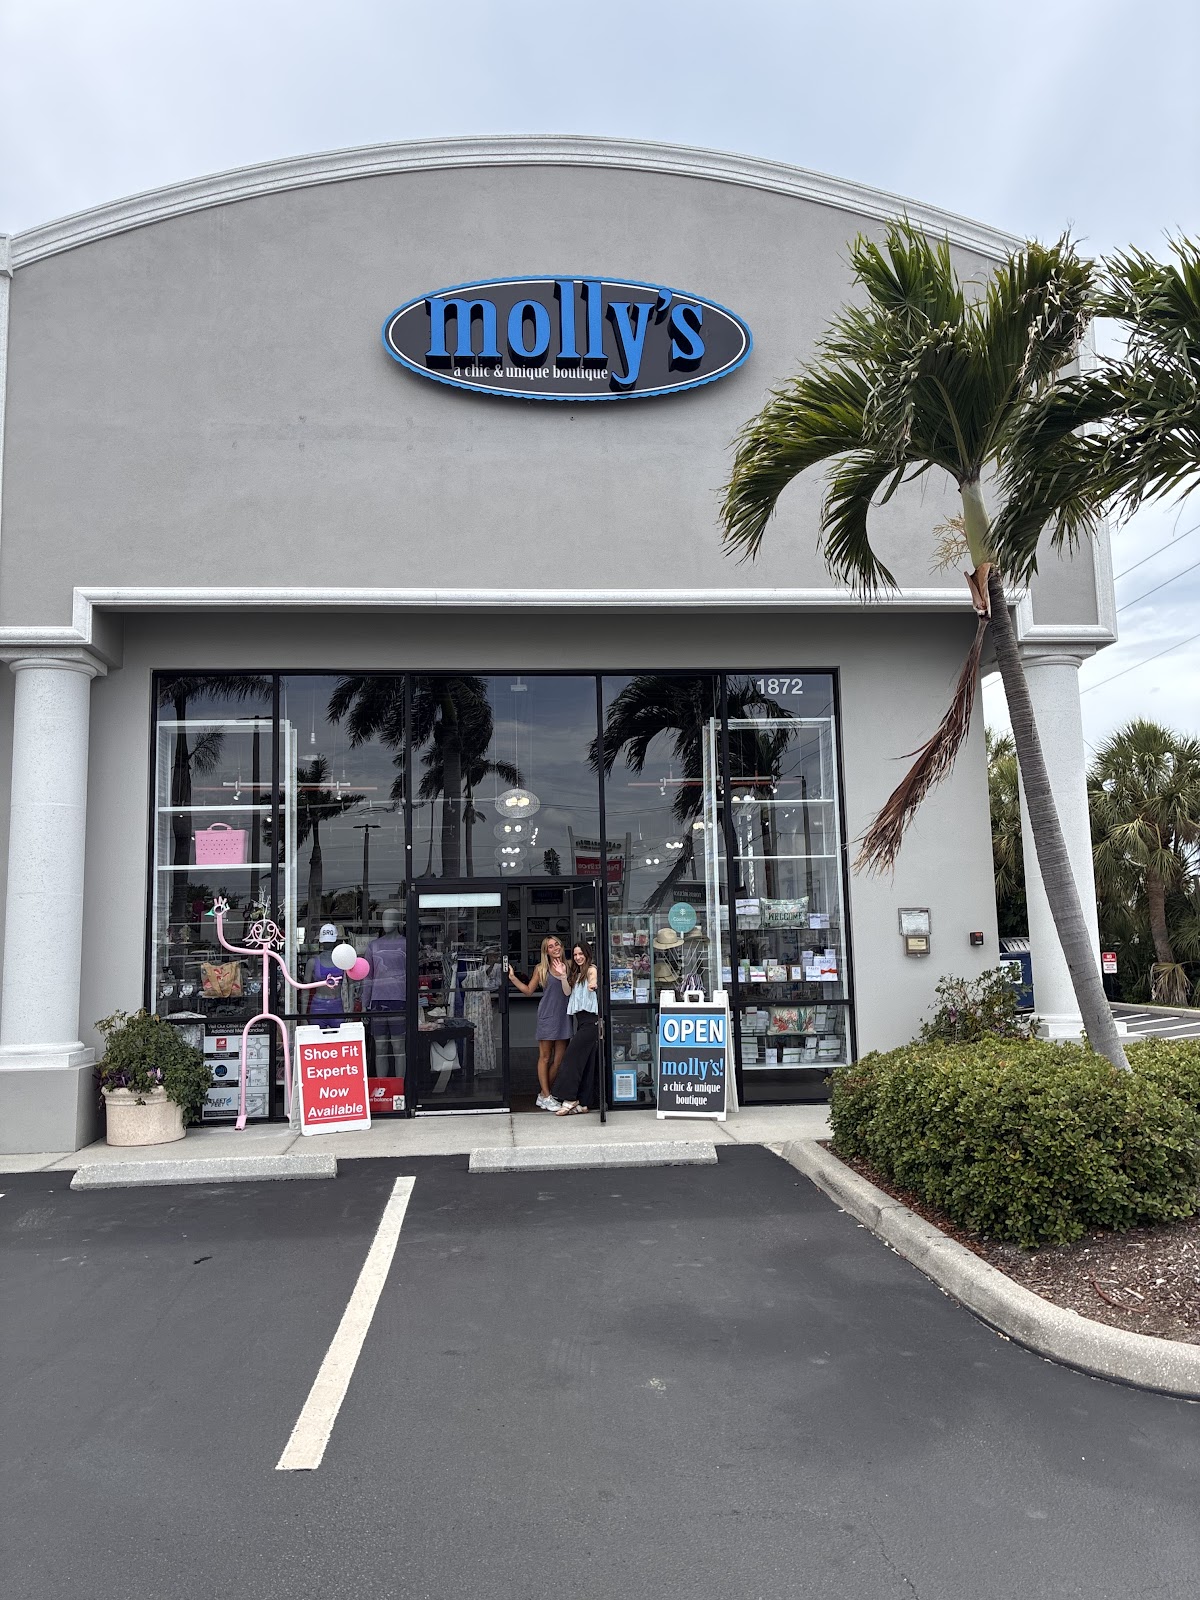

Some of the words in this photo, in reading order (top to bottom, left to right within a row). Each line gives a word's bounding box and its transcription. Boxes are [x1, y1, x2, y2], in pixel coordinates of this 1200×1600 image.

[425, 280, 705, 385] molly's
[453, 366, 462, 377] a
[464, 364, 490, 377] chic
[493, 364, 503, 377] &
[506, 366, 549, 380] unique
[552, 365, 608, 381] boutique
[757, 678, 803, 695] 1872
[768, 912, 802, 921] WELCOME
[662, 1019, 723, 1042] OPEN
[304, 1048, 338, 1060] Shoe
[342, 1045, 359, 1057] Fit
[307, 1064, 358, 1080] Experts
[661, 1057, 724, 1080] molly's!
[319, 1087, 349, 1099] Now
[663, 1083, 668, 1091] a
[669, 1081, 684, 1092] chic
[686, 1081, 693, 1092] &
[694, 1083, 721, 1094] unique
[675, 1094, 707, 1106] boutique
[307, 1103, 363, 1118] Available
